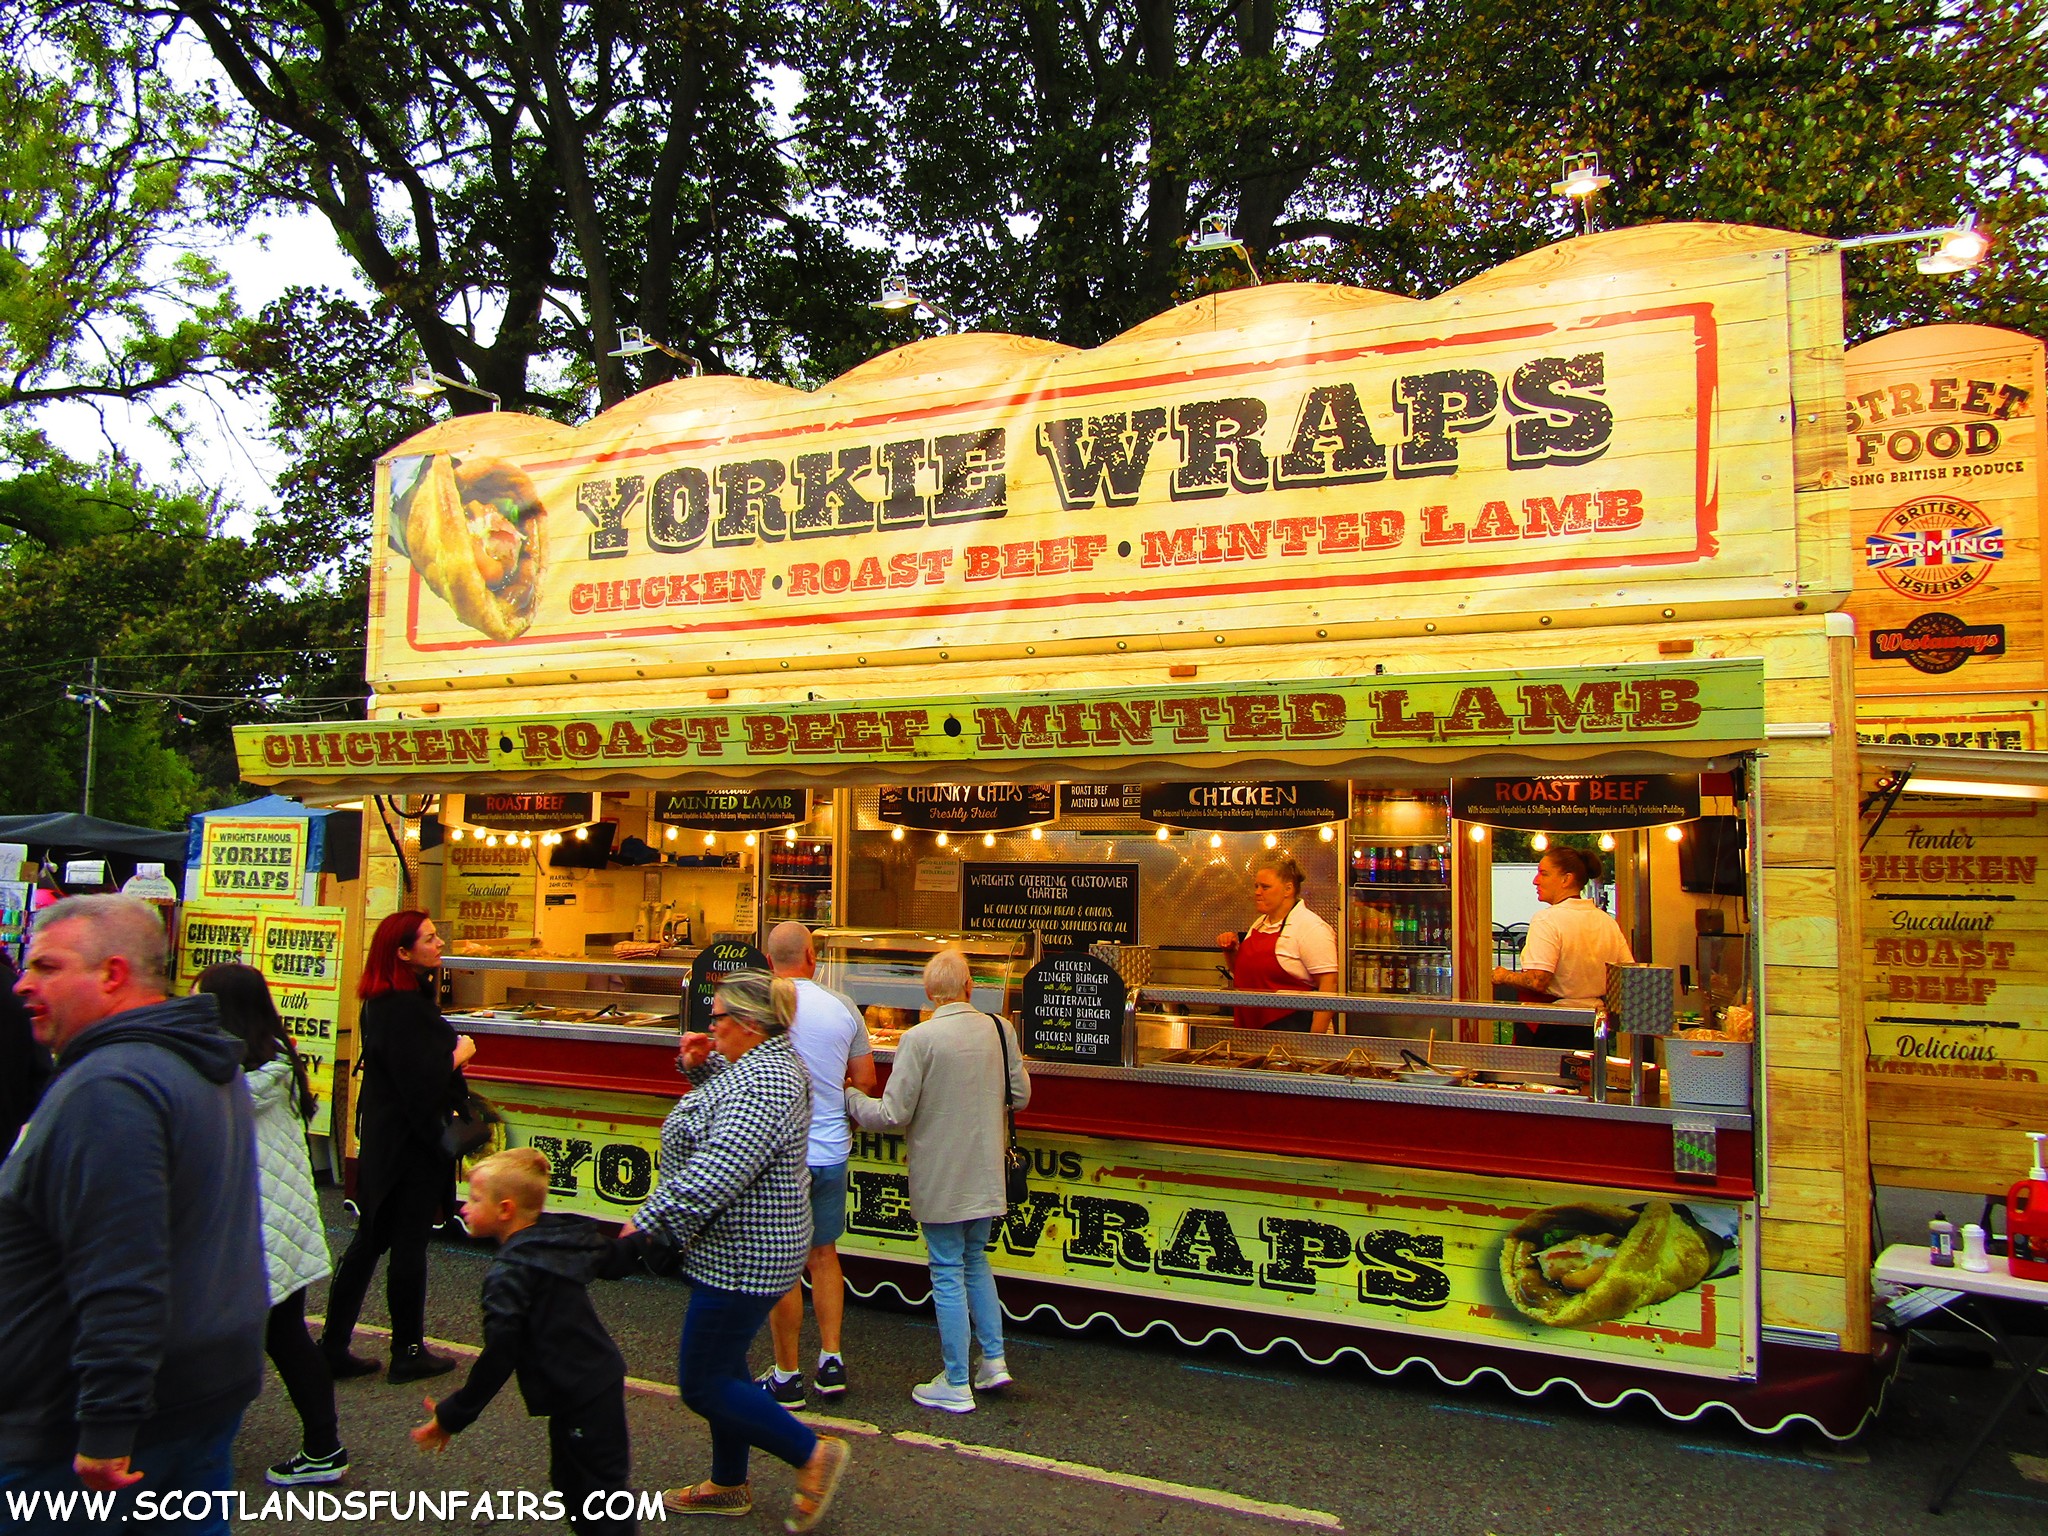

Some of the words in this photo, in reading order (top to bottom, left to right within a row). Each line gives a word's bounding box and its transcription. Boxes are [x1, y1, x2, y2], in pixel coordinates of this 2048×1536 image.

[1846, 378, 2031, 433] STREET
[1856, 422, 2001, 467] FOOD
[577, 427, 1007, 560] YORKIE
[1036, 351, 1613, 508] WRAPS
[1890, 467, 1947, 483] BRITISH
[1953, 461, 2024, 478] PRODUCE
[1895, 502, 1971, 526] BRITISH
[570, 566, 763, 614] CHICKEN
[787, 548, 954, 596] ROAST
[963, 533, 1107, 584] BEEF
[1141, 508, 1403, 570] MINTED
[1420, 488, 1645, 547] LAMB
[1871, 537, 1999, 560] FARMING
[1898, 571, 1974, 594] BRITISH
[1876, 632, 1998, 653] Westaways
[262, 727, 490, 768] CHICKEN
[519, 716, 730, 761] ROAST
[743, 709, 930, 755] BEEF
[973, 691, 1348, 752] MINTED
[1367, 678, 1702, 738] LAMB
[907, 785, 971, 803] CHUNKY
[977, 785, 1023, 802] CHIPS
[1071, 785, 1091, 795] ROAST
[1094, 785, 1108, 795] BEEF
[1188, 785, 1297, 806] CHICKEN
[1495, 781, 1581, 801] ROAST
[1589, 781, 1649, 800] BEEF
[486, 796, 532, 811] ROAST
[535, 795, 566, 811] BEEF
[667, 795, 738, 810] MINTED
[743, 795, 792, 810] LAMB
[1070, 797, 1098, 808] MINTED
[1101, 797, 1120, 808] LAMB
[929, 808, 969, 822] Freshly
[970, 807, 998, 819] Fried
[220, 833, 256, 843] WRIGHTS
[257, 833, 291, 842] FAMOUS
[1905, 829, 1975, 850] Tender
[213, 846, 292, 866] YORKIE
[451, 848, 531, 866] CHICKEN
[214, 870, 290, 890] WRAPS
[1860, 855, 2038, 885] CHICKEN
[467, 883, 512, 897] Succulant
[971, 874, 1014, 887] WRIGHTS
[1019, 875, 1066, 888] CATERING
[1072, 876, 1128, 888] CUSTOMER
[1027, 887, 1068, 899] CHARTER
[458, 901, 519, 921] ROAST
[984, 903, 994, 914] WE
[996, 904, 1013, 915] ONLY
[1015, 904, 1028, 915] USE
[1030, 904, 1051, 916] FRESH
[1053, 905, 1075, 917] BREAD
[1078, 906, 1083, 917] &
[970, 917, 980, 928] WE
[982, 918, 995, 928] USE
[998, 918, 1026, 930] LOCALLY
[1028, 919, 1059, 930] SOURCED
[1060, 920, 1097, 932] SUPPLIERS
[1099, 921, 1113, 932] FOR
[1114, 922, 1128, 933] ALL
[1891, 910, 1994, 932] Succulant
[188, 923, 253, 947] CHUNKY
[266, 927, 337, 953] CHUNKY
[462, 925, 509, 939] BEEF
[1041, 934, 1074, 945] RODUCTS.
[193, 949, 242, 967] CHIPS
[713, 944, 748, 959] Hot
[1874, 937, 2015, 970] ROAST
[273, 952, 327, 977] CHIPS
[1054, 960, 1091, 972] CHICKEN
[1038, 971, 1072, 983] ZINGER
[1075, 973, 1109, 984] BURGER
[1043, 993, 1102, 1007] BUTTERMILK
[1888, 974, 1997, 1006] BEEF
[281, 991, 309, 1010] with
[1035, 1005, 1072, 1017] CHICKEN
[1076, 1007, 1111, 1020] BURGER
[282, 1015, 332, 1040] EESE
[1035, 1030, 1072, 1042] CHICKEN
[1076, 1032, 1110, 1045] BURGER
[1896, 1035, 1997, 1062] Delicious
[984, 1188, 1452, 1313] WRAPS
